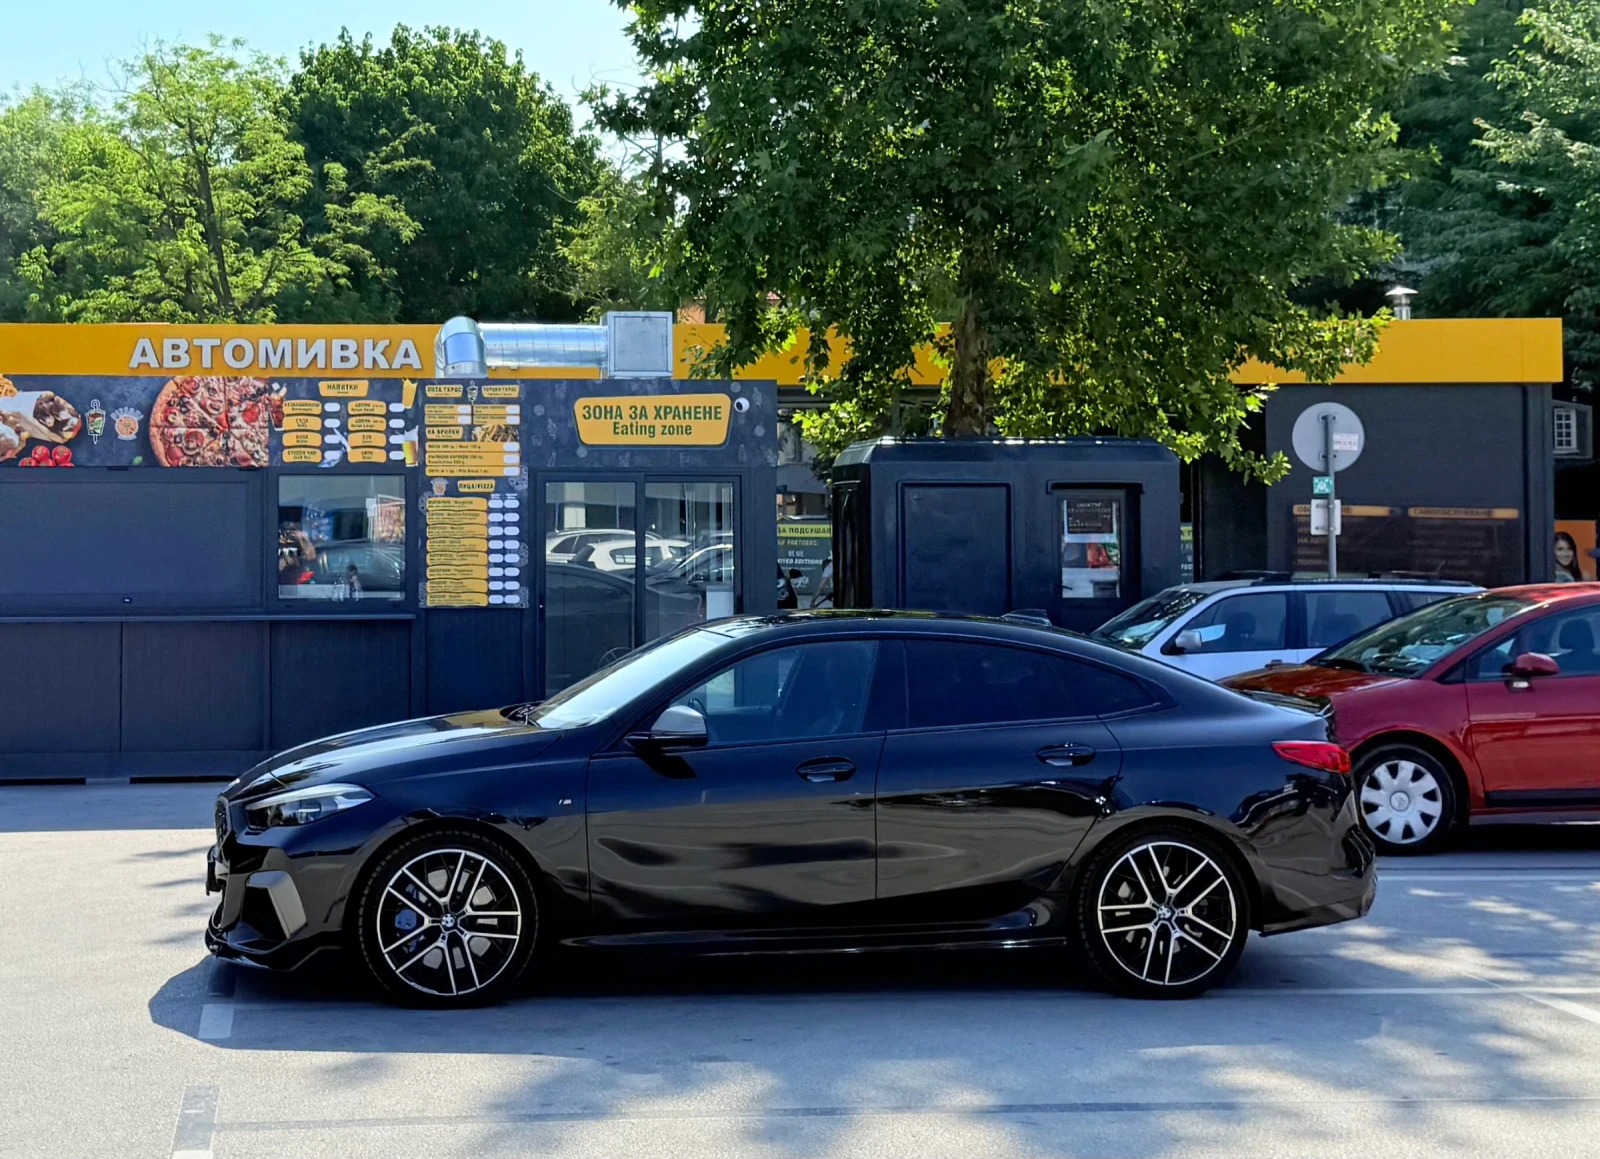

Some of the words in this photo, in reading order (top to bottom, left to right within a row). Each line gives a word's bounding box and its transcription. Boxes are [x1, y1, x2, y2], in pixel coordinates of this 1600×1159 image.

[128, 338, 423, 370] АВТОМИВКА
[582, 405, 628, 420] ЗОНА
[634, 406, 653, 420] ЗА
[658, 406, 722, 420] ХРАНЕНЕ
[612, 421, 656, 438] Eating
[665, 424, 693, 436] zone
